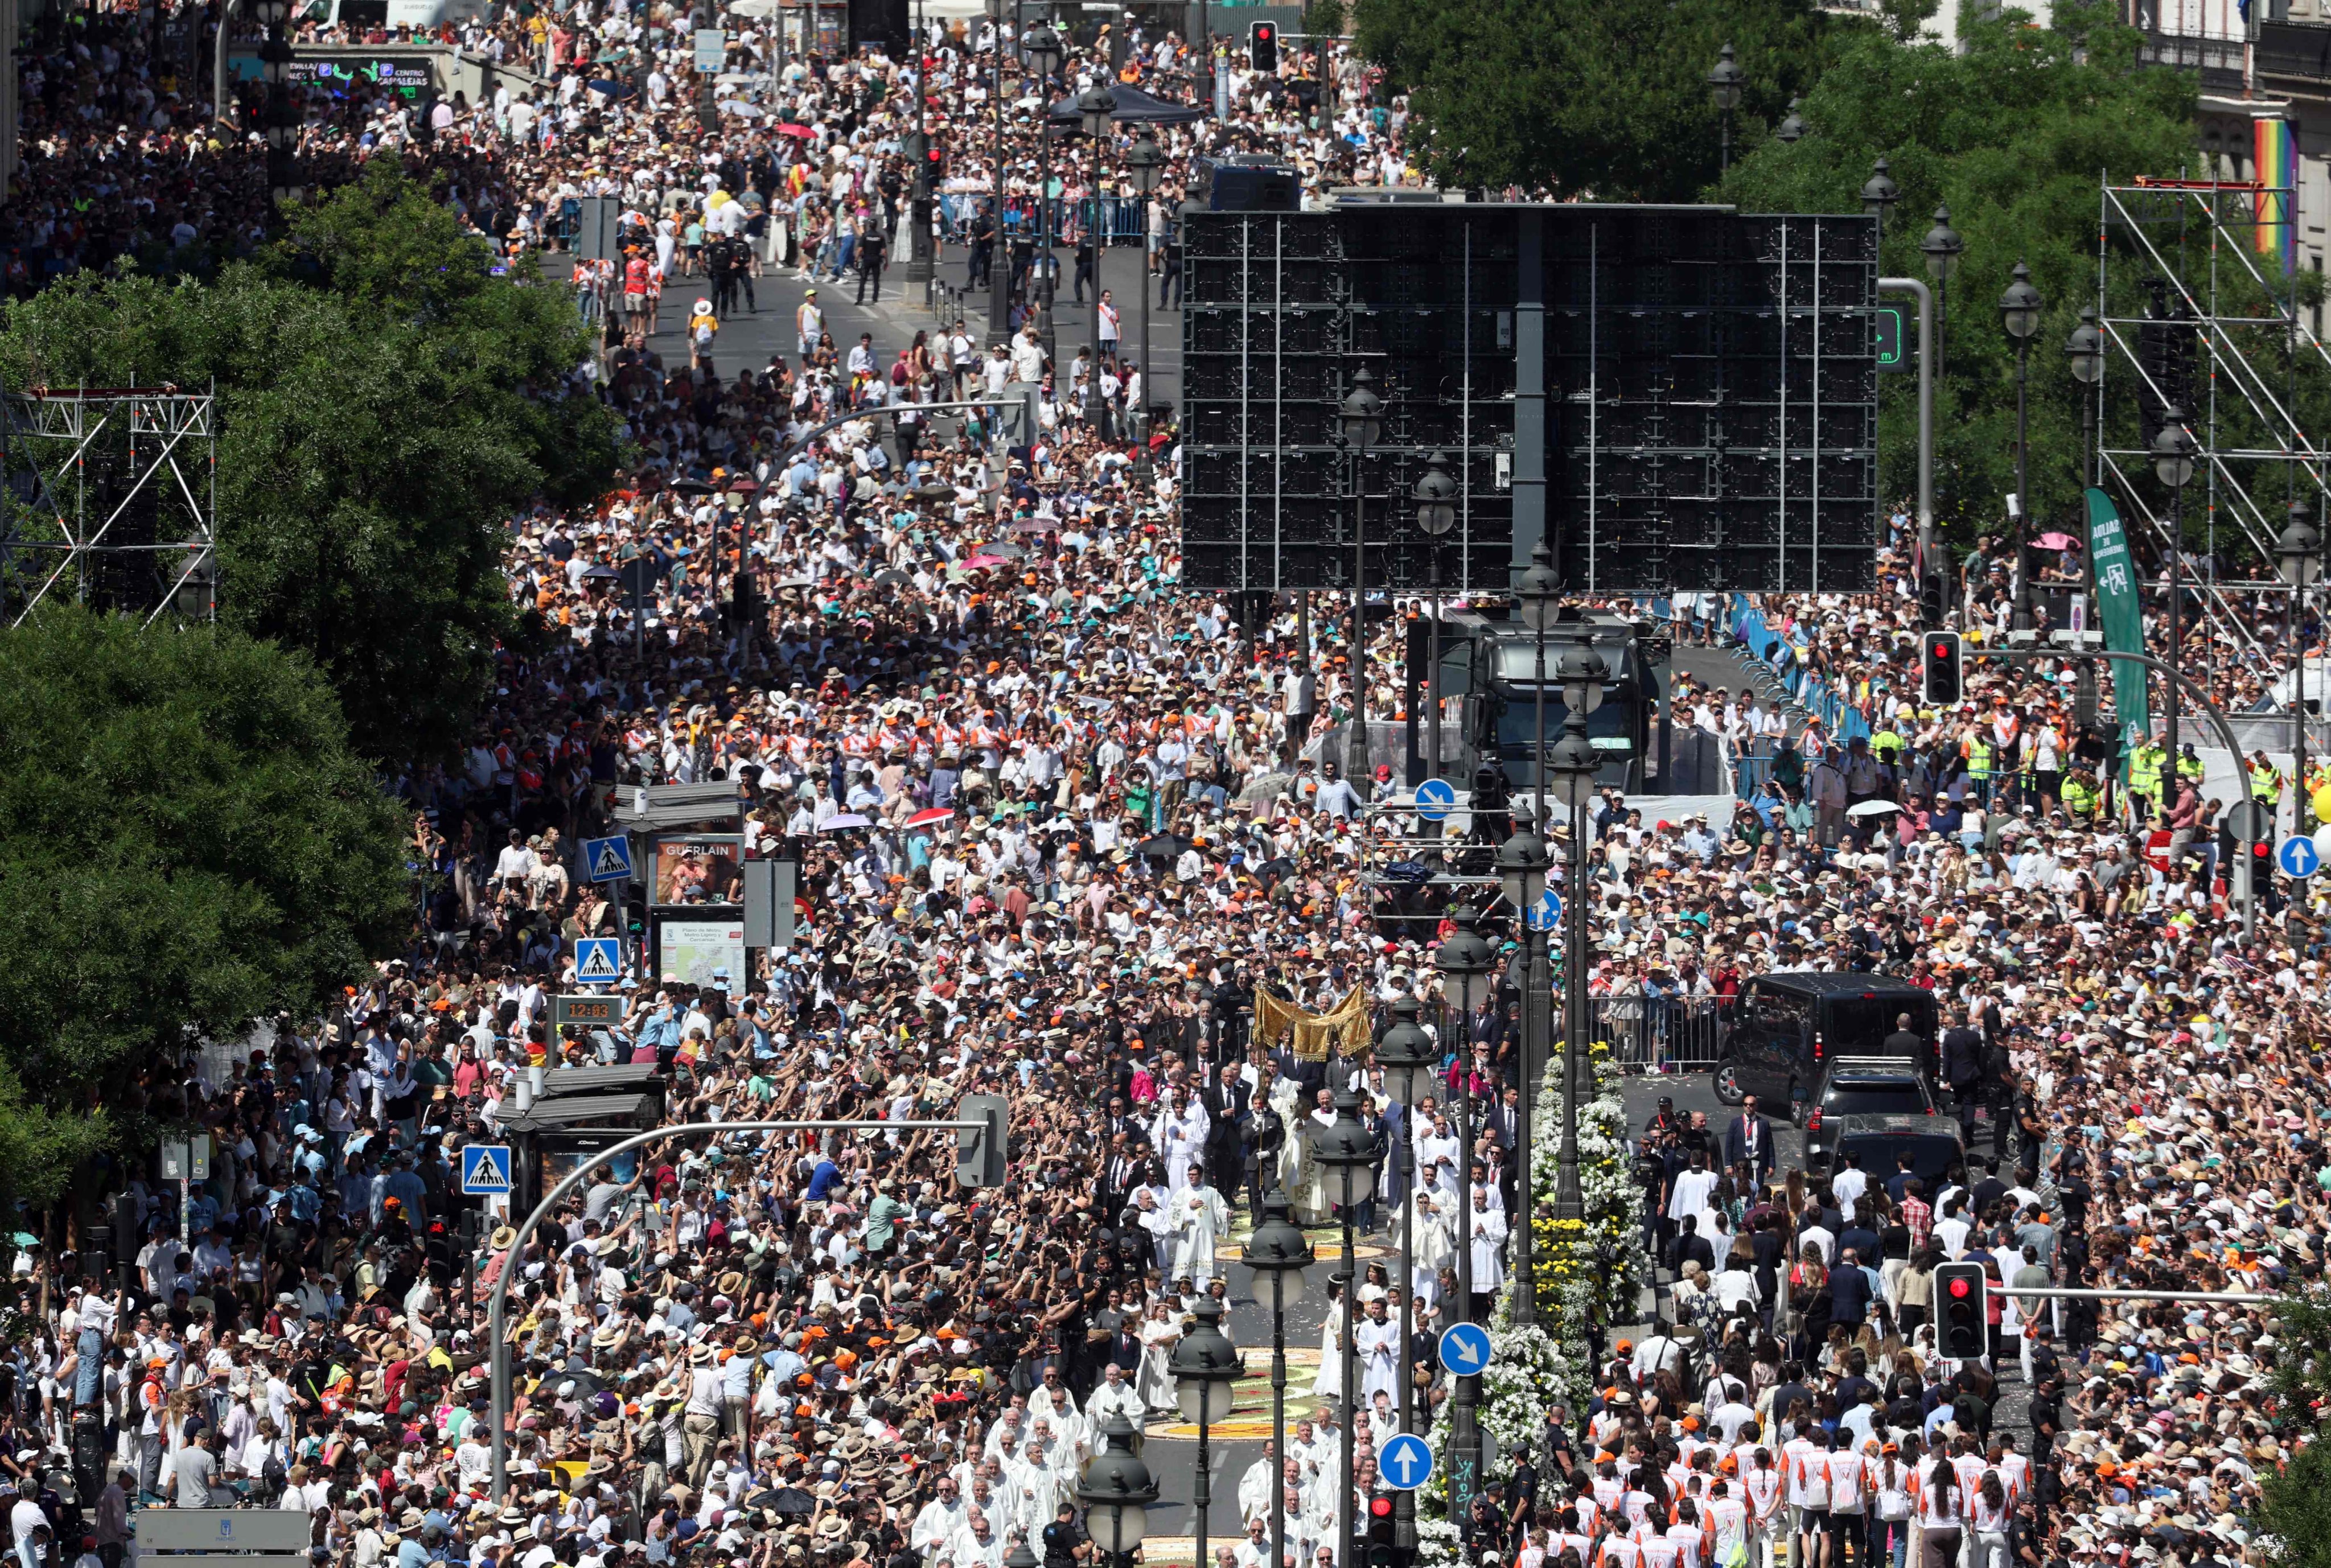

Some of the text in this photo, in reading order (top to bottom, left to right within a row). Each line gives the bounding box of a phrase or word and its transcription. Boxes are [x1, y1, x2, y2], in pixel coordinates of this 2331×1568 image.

[666, 846, 729, 855] GUERLAIN
[1967, 1476, 1975, 1485] V
[1631, 1513, 1640, 1522] V
